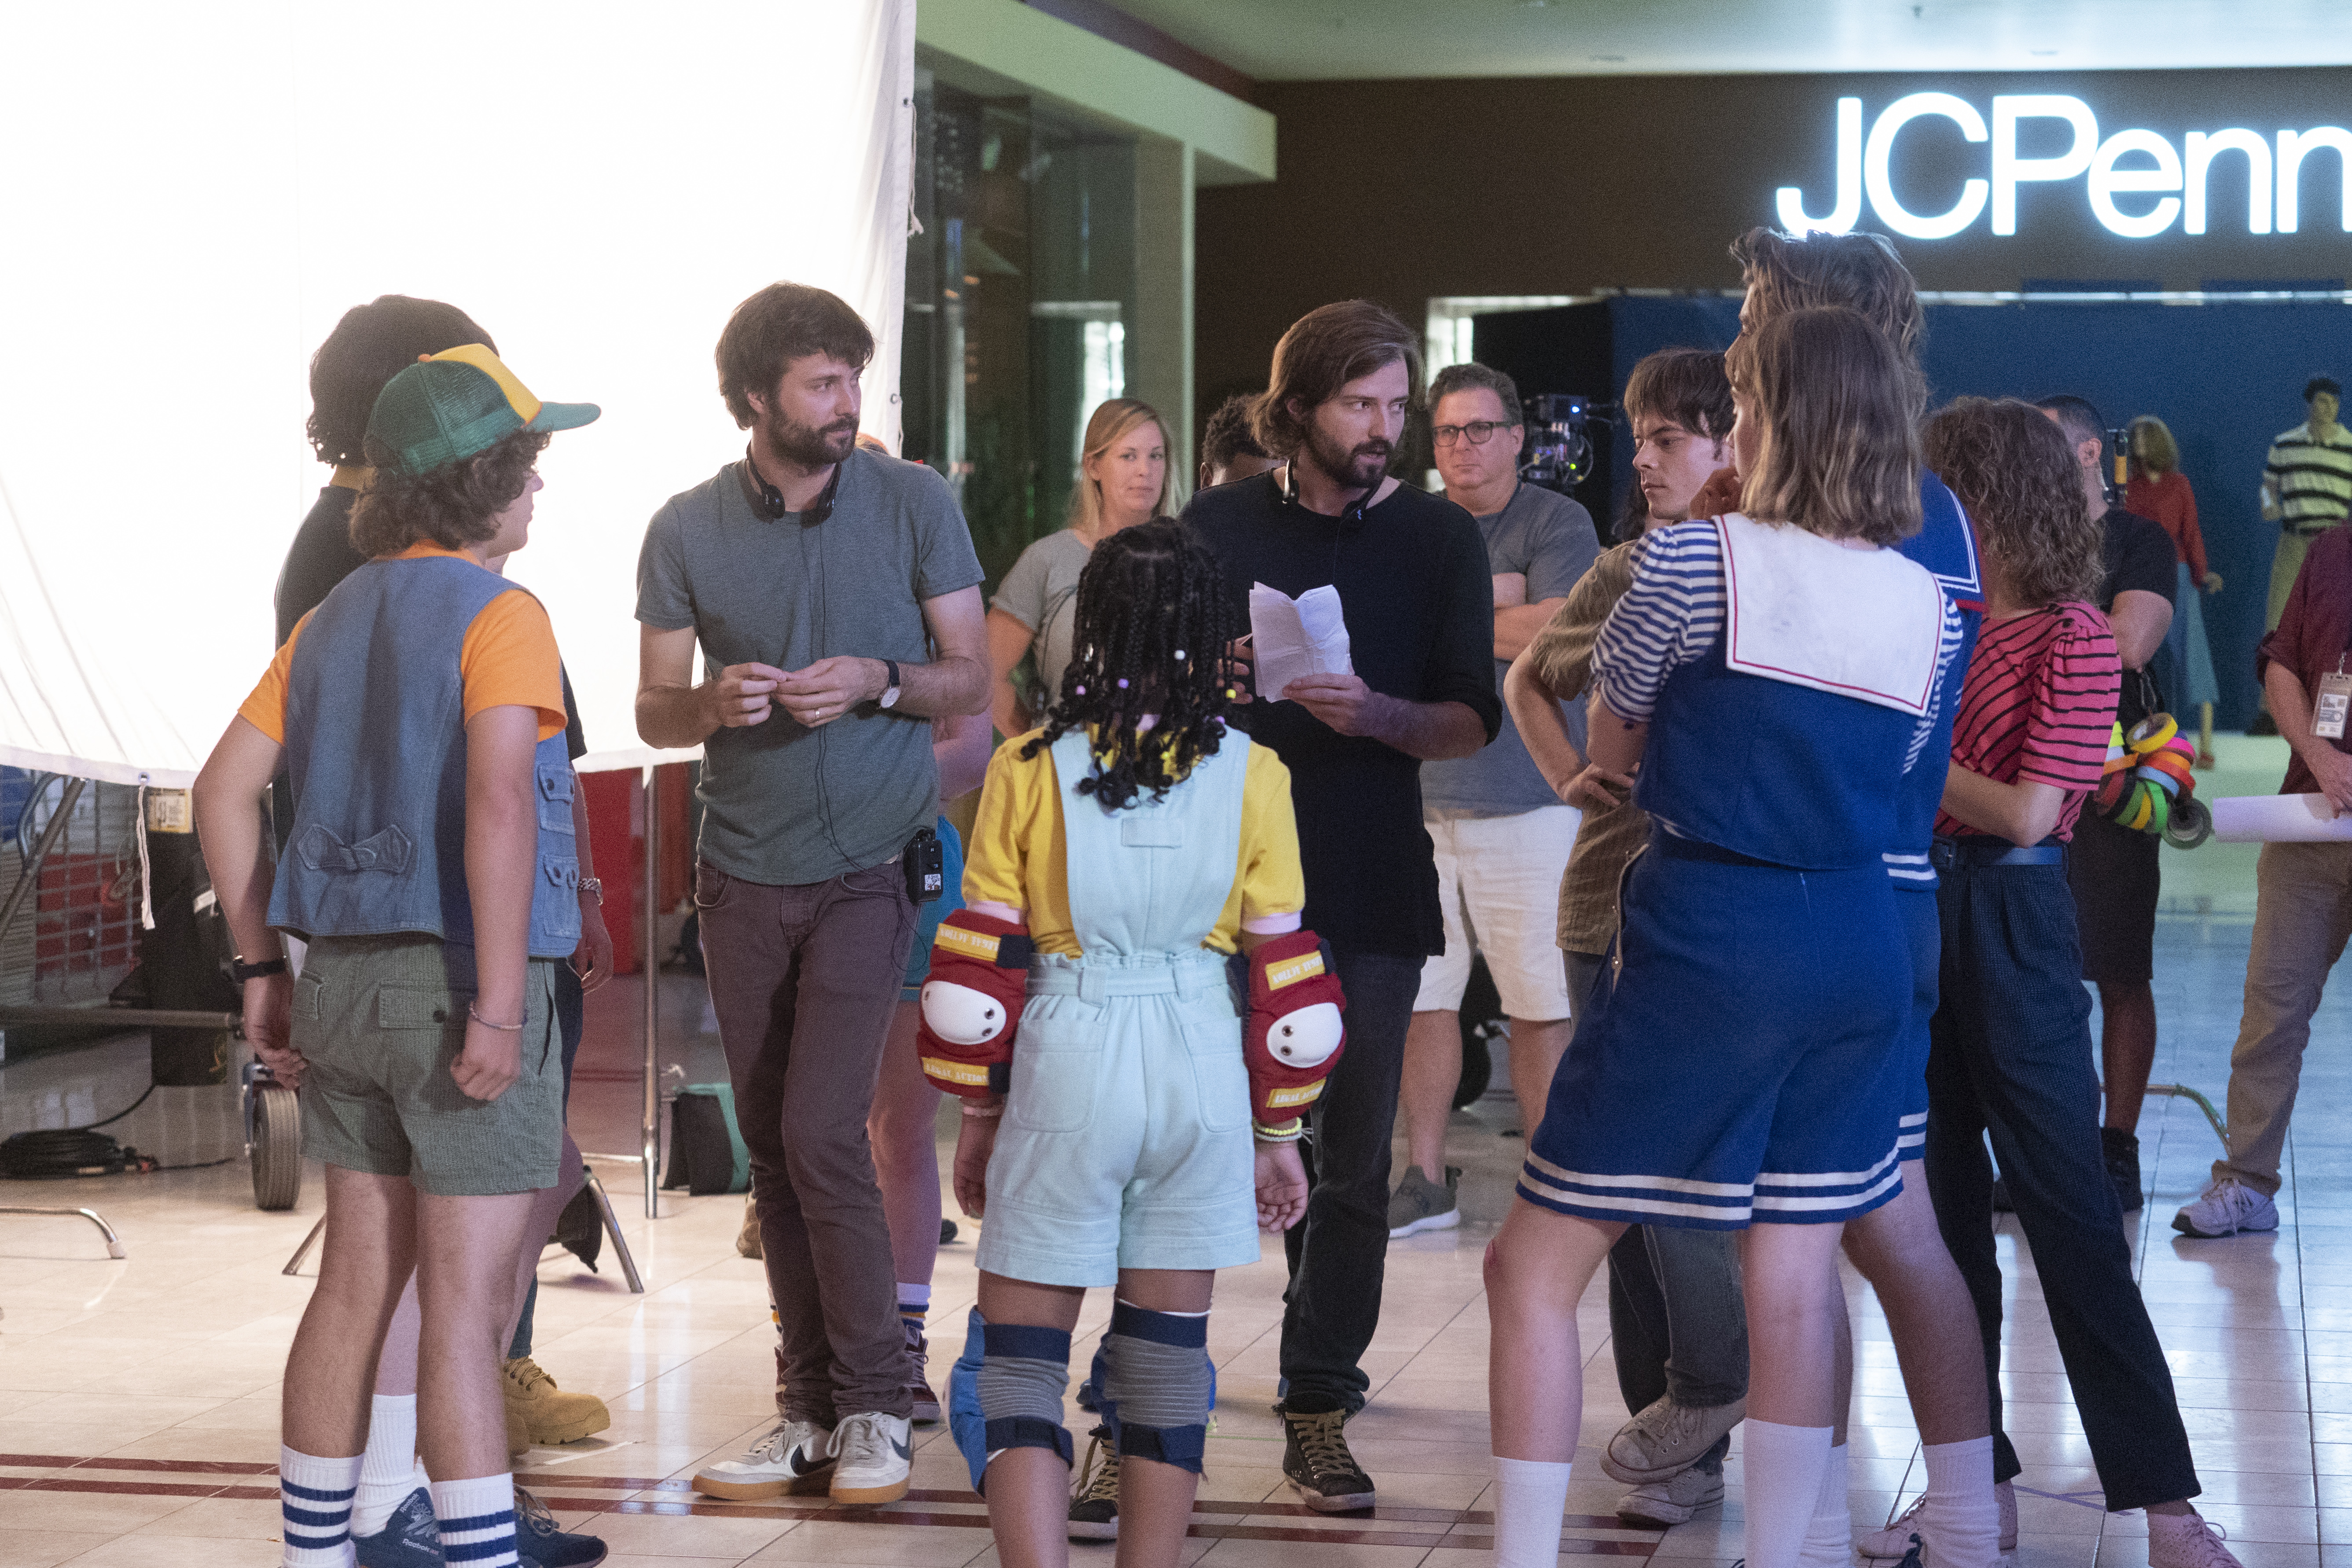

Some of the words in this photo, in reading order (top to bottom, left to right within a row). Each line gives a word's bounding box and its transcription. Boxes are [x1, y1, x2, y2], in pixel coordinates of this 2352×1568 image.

[1775, 92, 2352, 239] JCPenn
[400, 1493, 419, 1513] Reebok
[402, 1539, 430, 1552] Reebok
